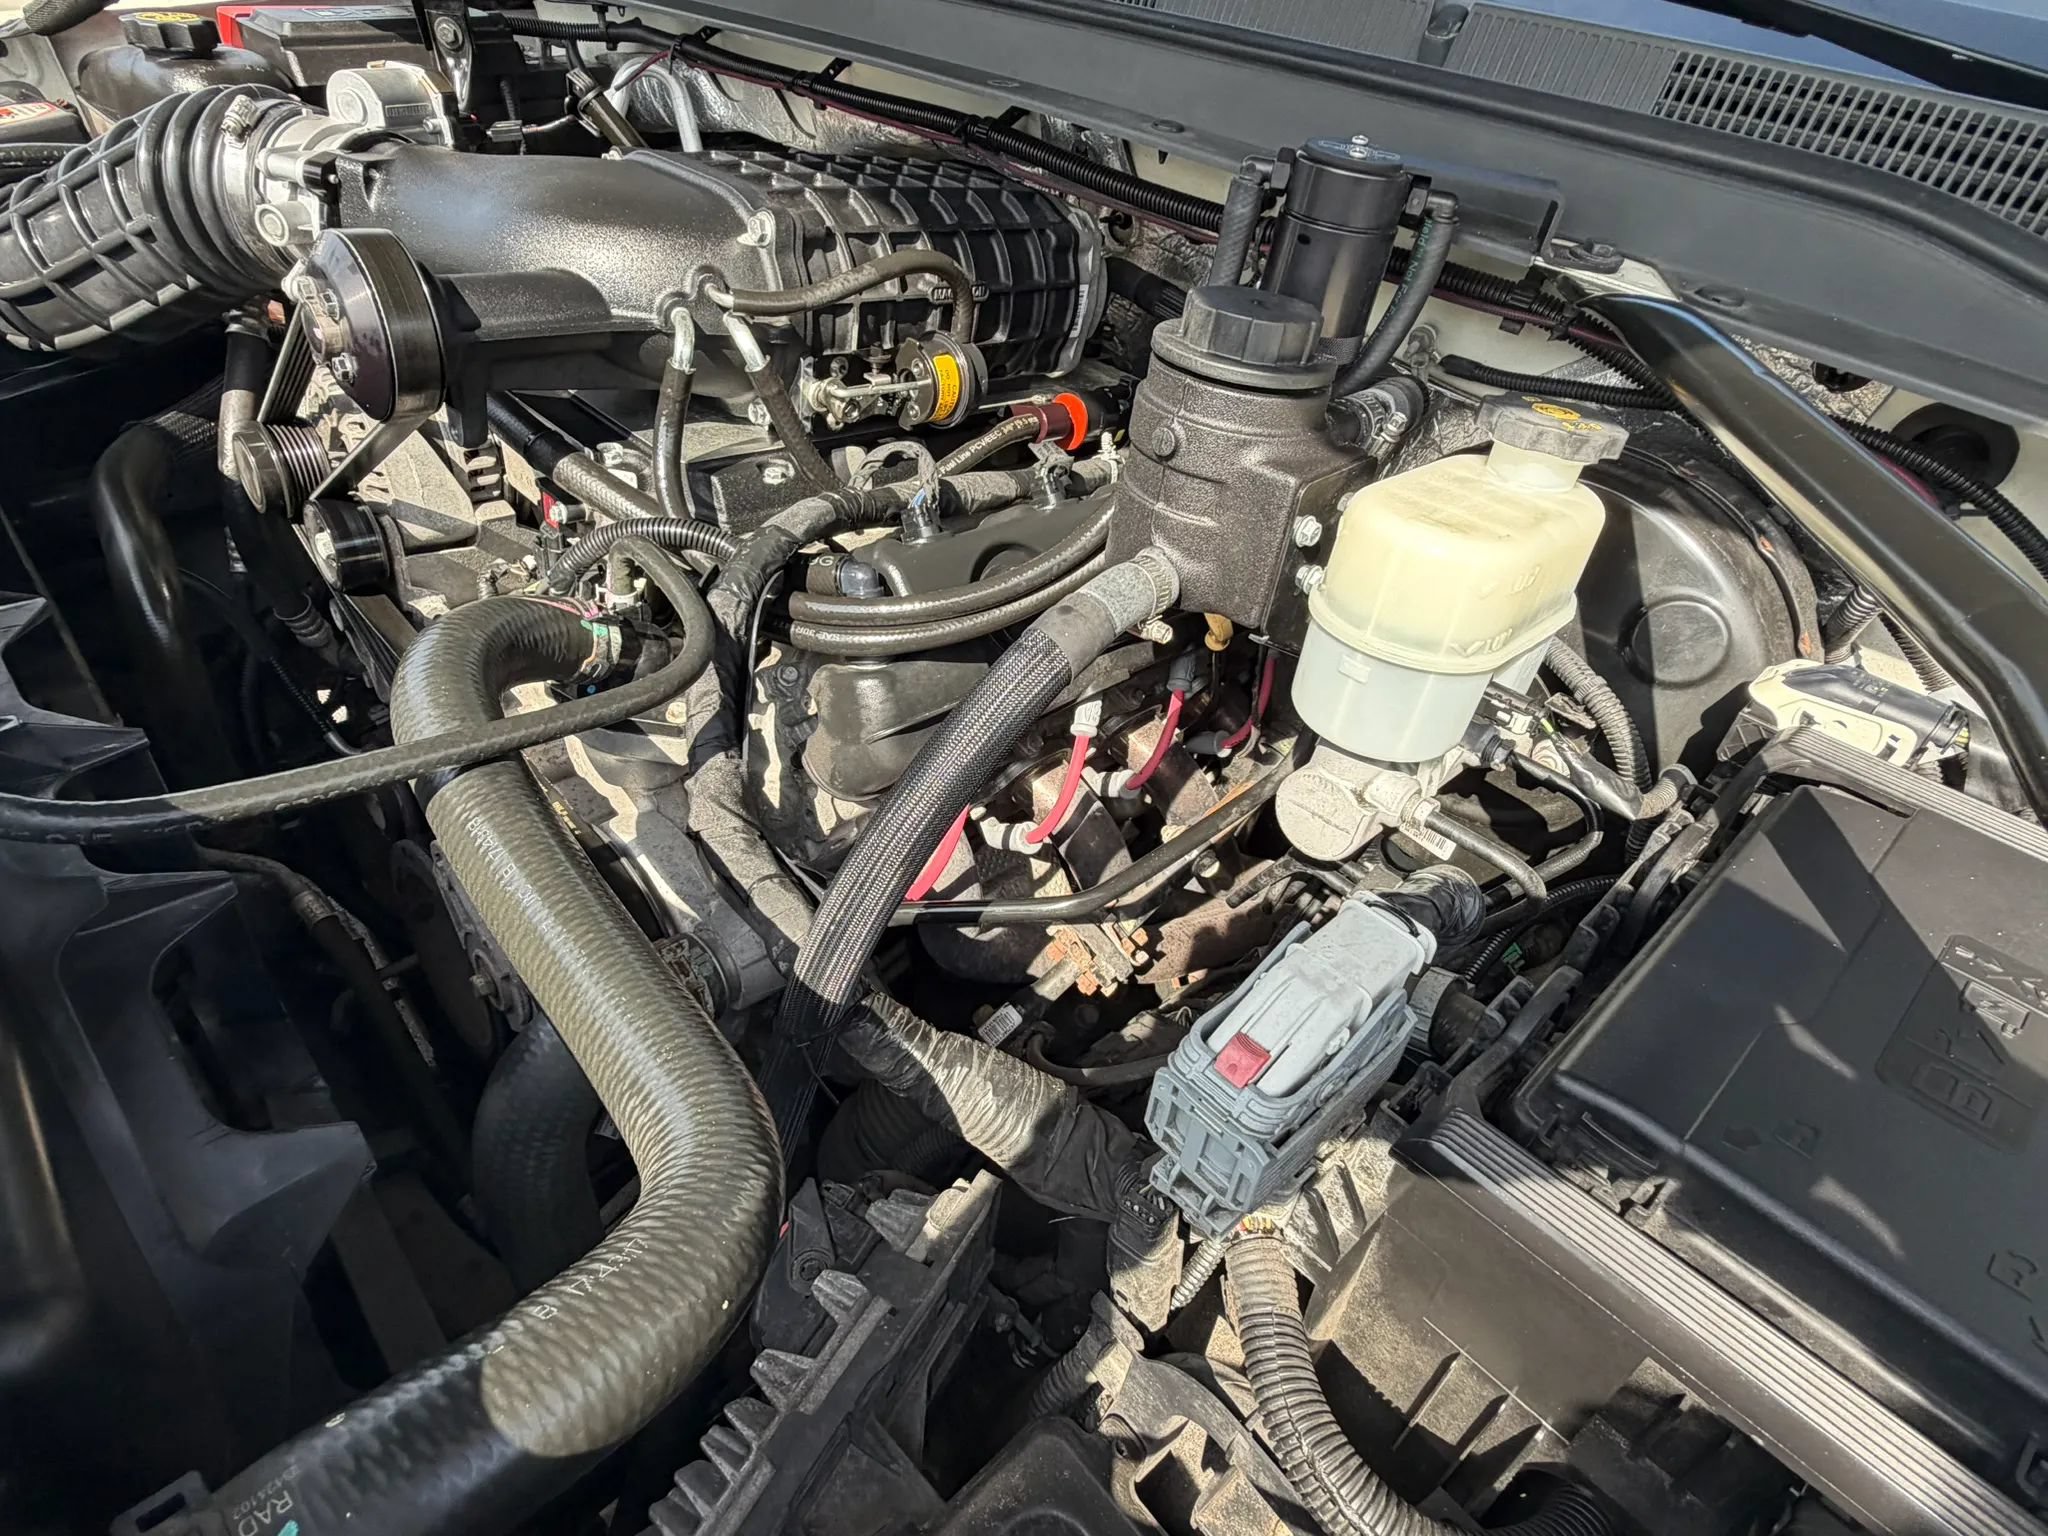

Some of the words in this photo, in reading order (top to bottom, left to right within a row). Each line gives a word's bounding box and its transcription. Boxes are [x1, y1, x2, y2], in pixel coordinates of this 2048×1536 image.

[940, 461, 957, 475] Fuel
[954, 451, 972, 464] Line
[969, 430, 1002, 453] PCV/EEC
[238, 1490, 293, 1536] RAD
